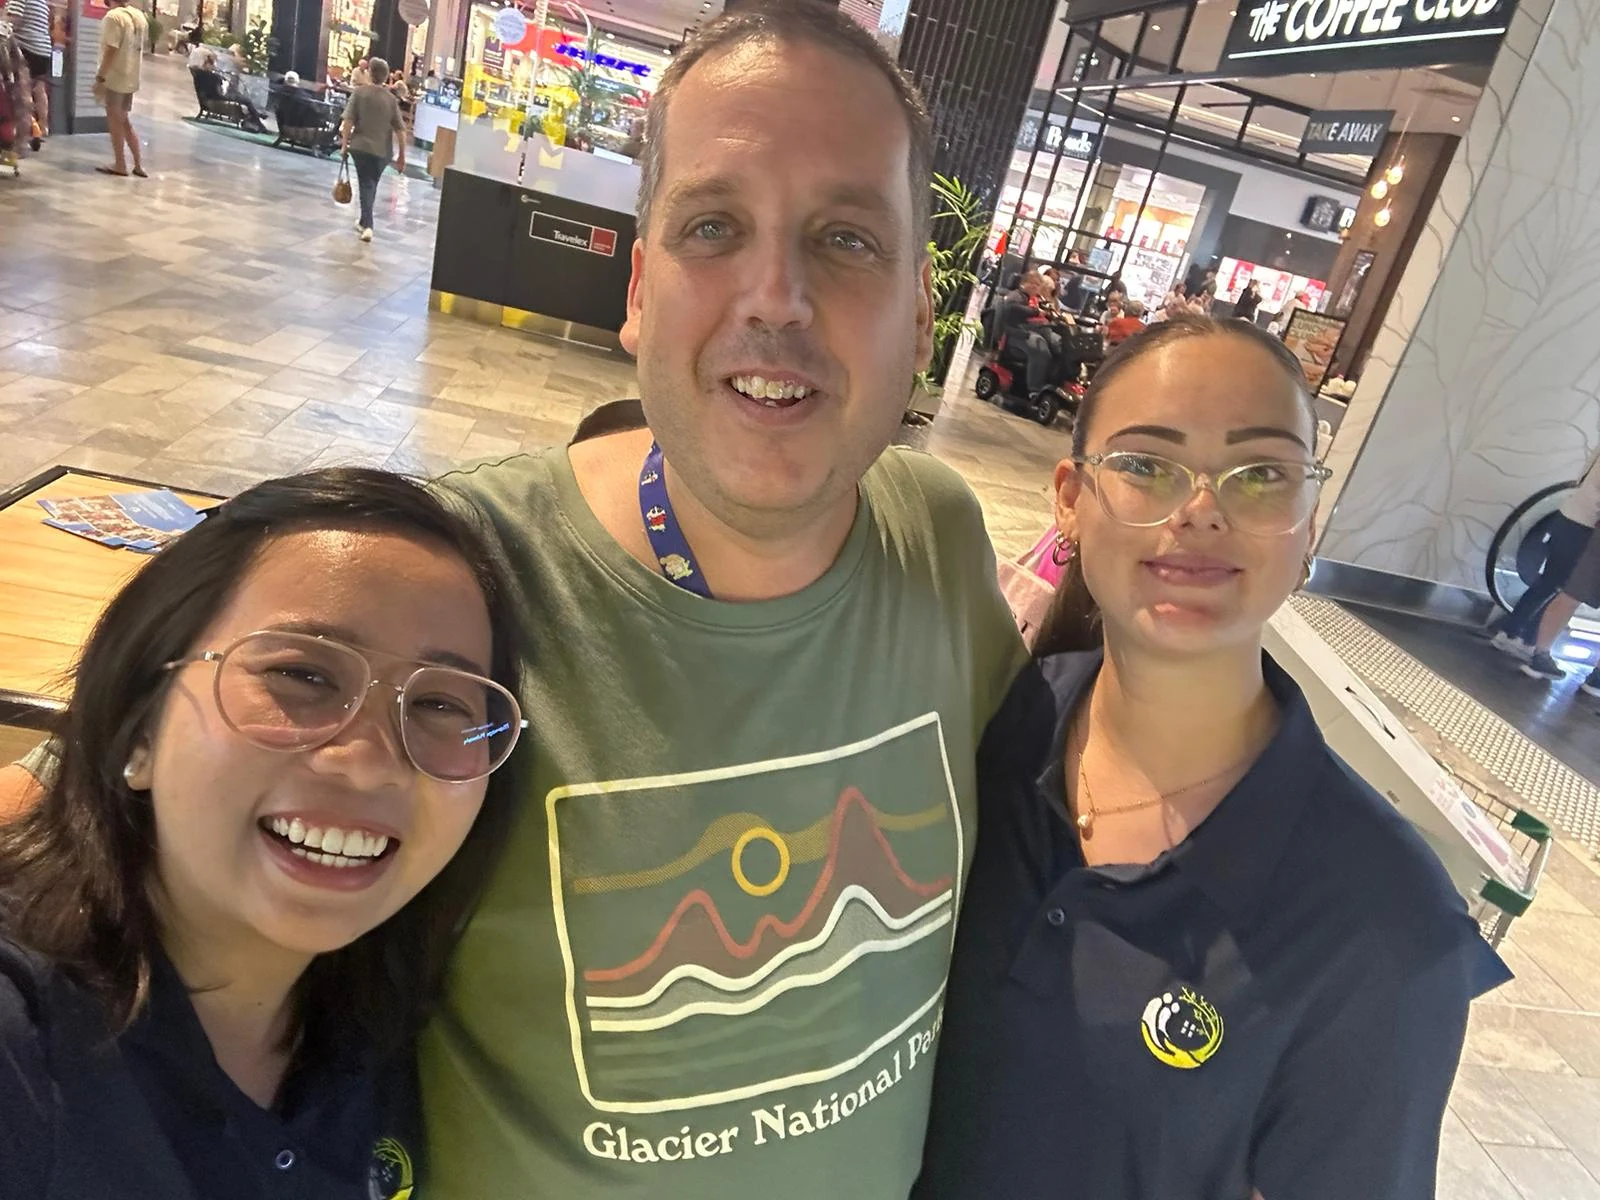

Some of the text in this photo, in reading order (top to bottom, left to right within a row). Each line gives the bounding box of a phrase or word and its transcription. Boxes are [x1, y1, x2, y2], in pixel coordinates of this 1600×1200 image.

[1249, 1, 1289, 42] THE
[1284, 0, 1410, 42] COFFEE
[1306, 122, 1384, 142] TAKE AWAY
[553, 229, 588, 247] Travelex
[582, 1121, 740, 1164] Glacier
[750, 1049, 904, 1147] National
